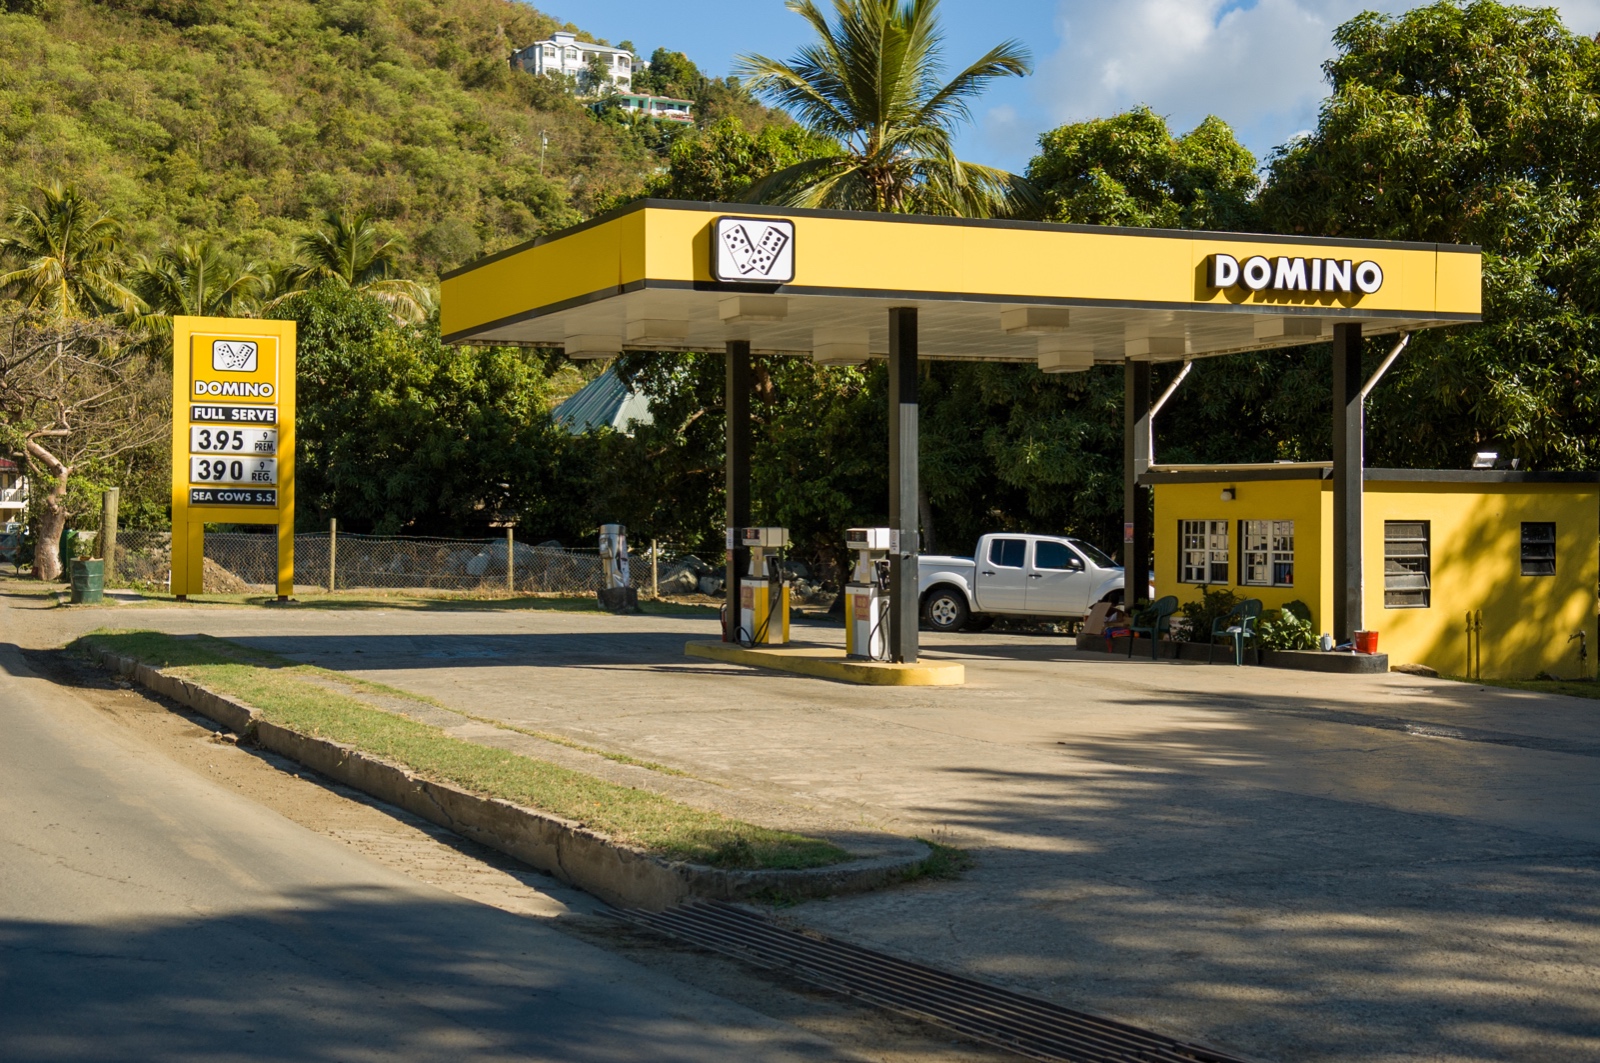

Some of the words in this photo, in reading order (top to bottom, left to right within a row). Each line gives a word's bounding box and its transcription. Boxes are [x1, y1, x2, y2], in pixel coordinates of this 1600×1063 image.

[1210, 253, 1383, 294] DOMINO
[194, 380, 274, 397] DOMINO
[194, 407, 225, 420] FULL
[231, 409, 274, 421] SERVE
[198, 429, 244, 450] 3.95
[263, 432, 268, 440] 9
[254, 442, 275, 452] PREM.
[259, 461, 265, 470] 9
[251, 472, 272, 482] REG.
[192, 491, 213, 501] SEA
[217, 492, 251, 501] COWS
[256, 493, 275, 502] S.S.
